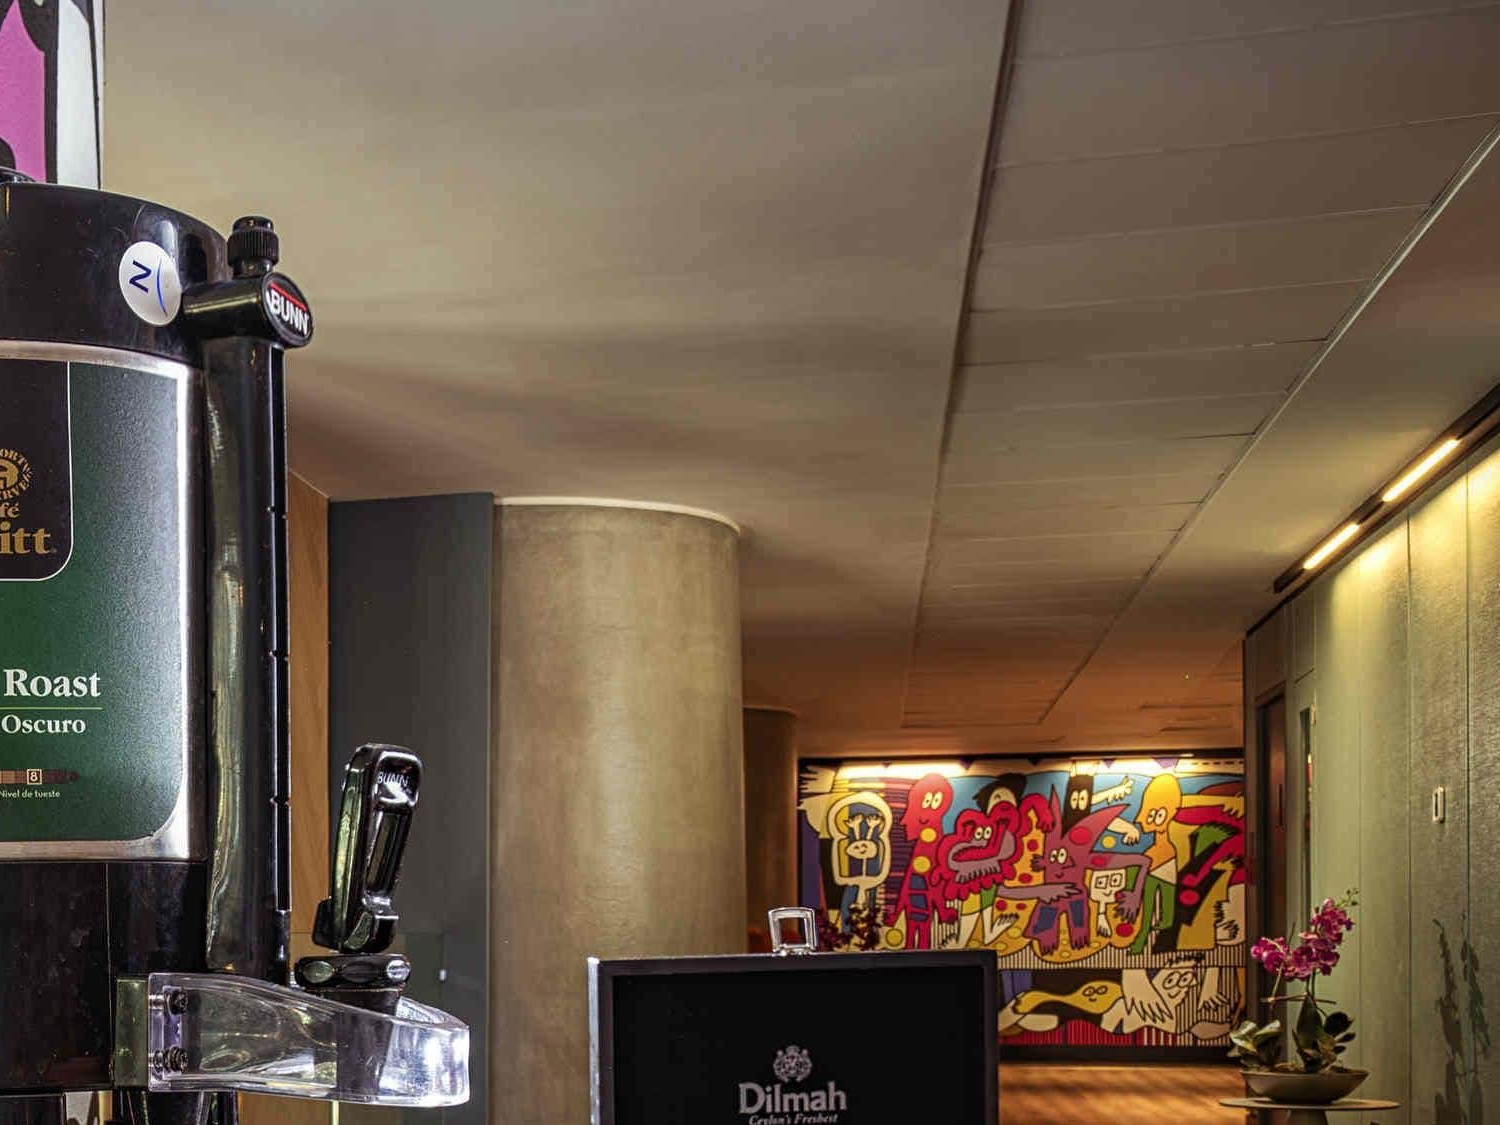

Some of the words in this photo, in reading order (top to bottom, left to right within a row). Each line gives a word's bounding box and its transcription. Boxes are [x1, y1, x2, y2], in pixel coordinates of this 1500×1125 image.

[265, 288, 309, 335] BUNN
[3, 668, 102, 698] Roast
[1, 714, 86, 734] Oscuro
[29, 771, 39, 782] 8
[377, 770, 409, 787] BUNN
[21, 789, 33, 798] de
[34, 789, 61, 798] tueste
[738, 1080, 848, 1114] Dilmah
